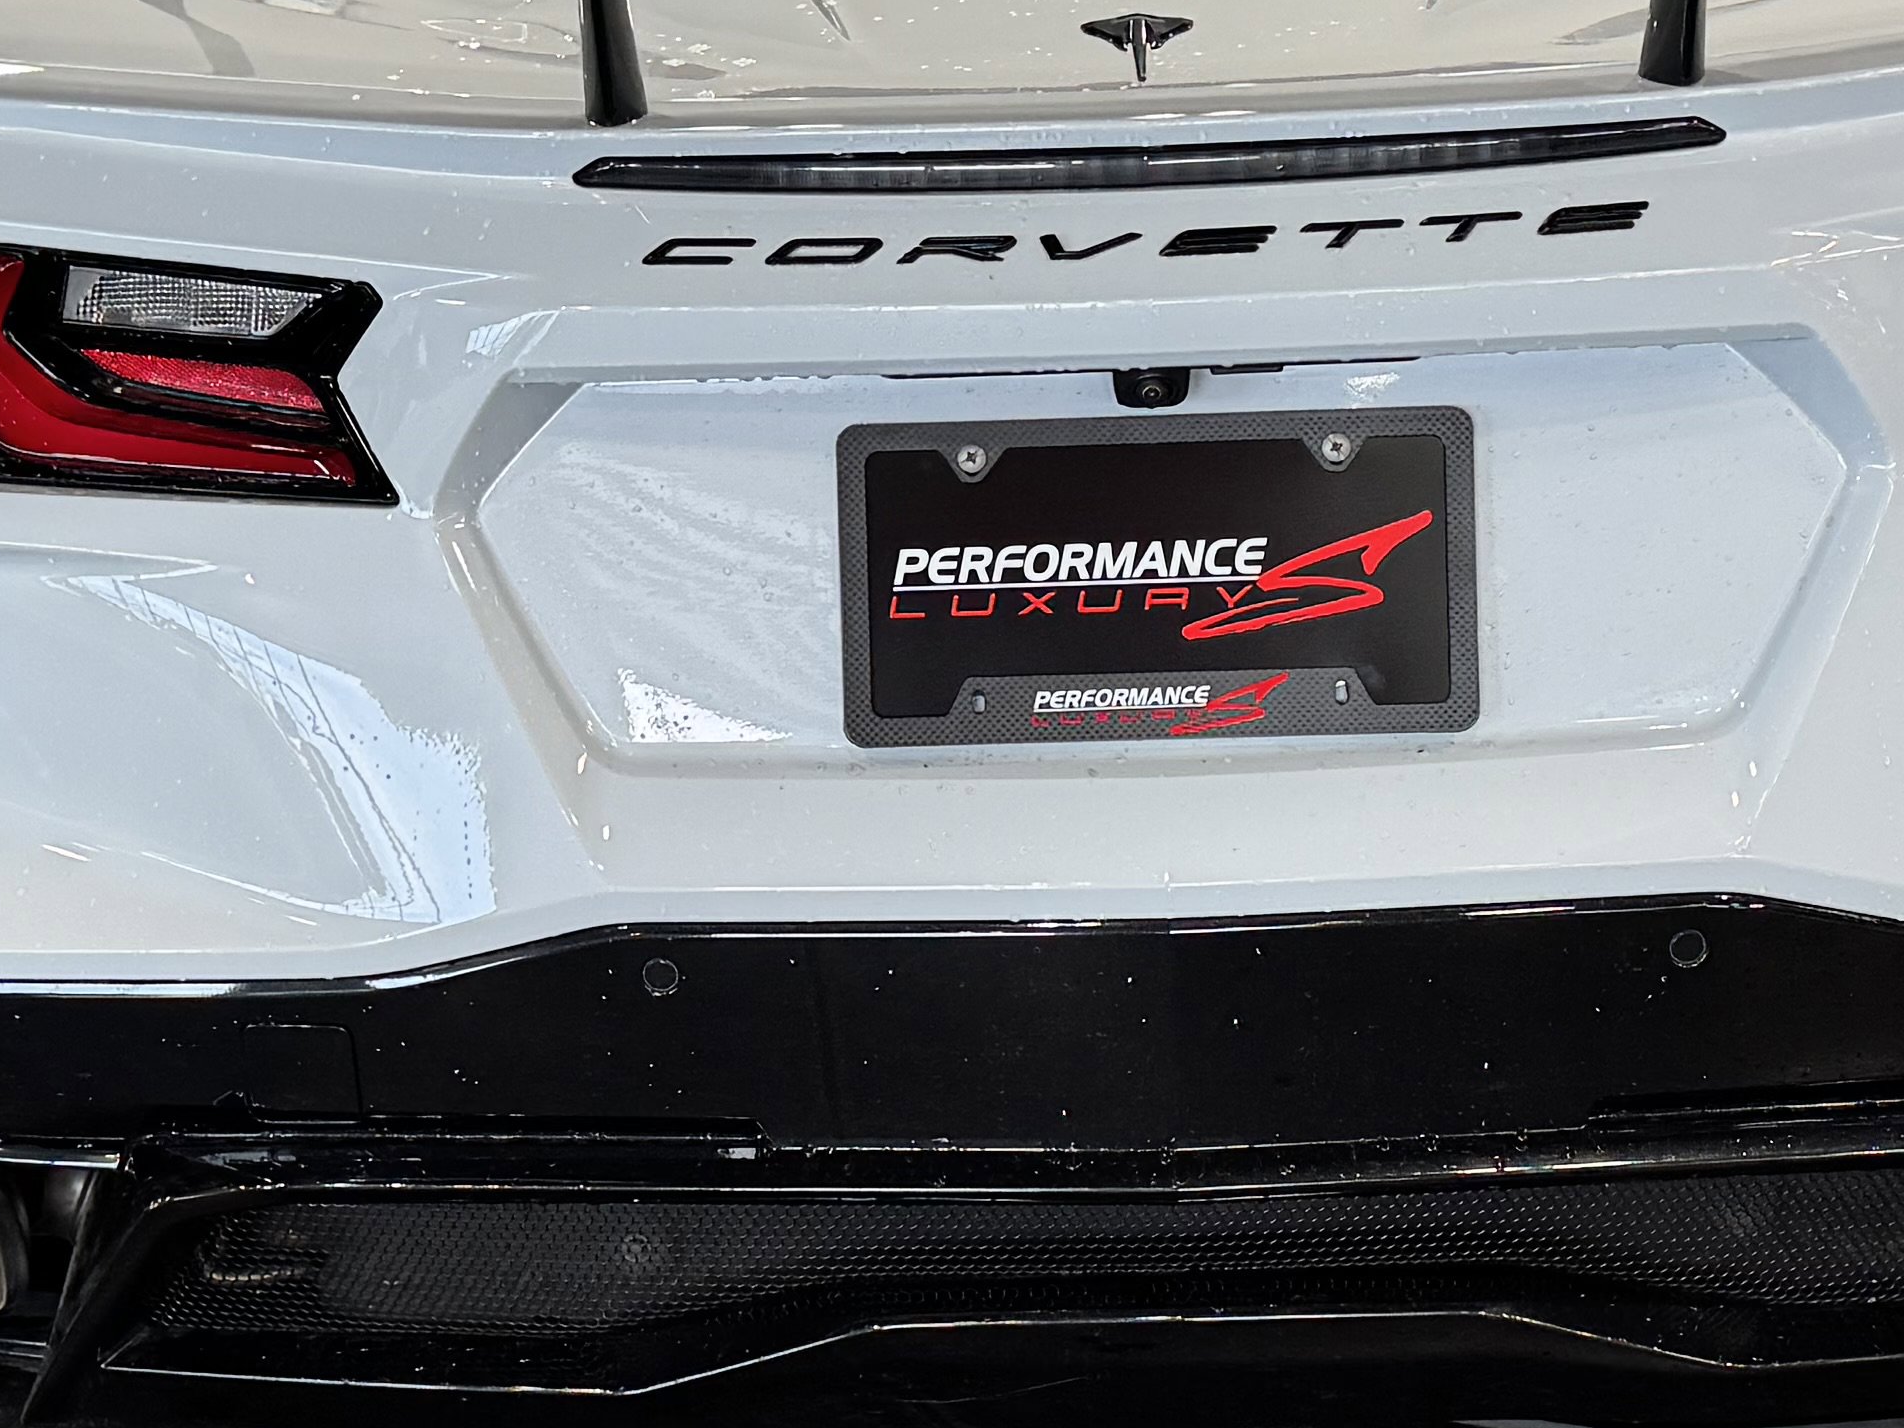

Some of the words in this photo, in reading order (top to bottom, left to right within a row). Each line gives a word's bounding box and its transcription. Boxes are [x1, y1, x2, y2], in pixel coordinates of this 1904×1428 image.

[641, 201, 1649, 265] CORVETTE
[894, 537, 1268, 583] PERFORMANCE
[889, 586, 1253, 618] LUXURY
[1033, 685, 1211, 709] PERFORMANCE
